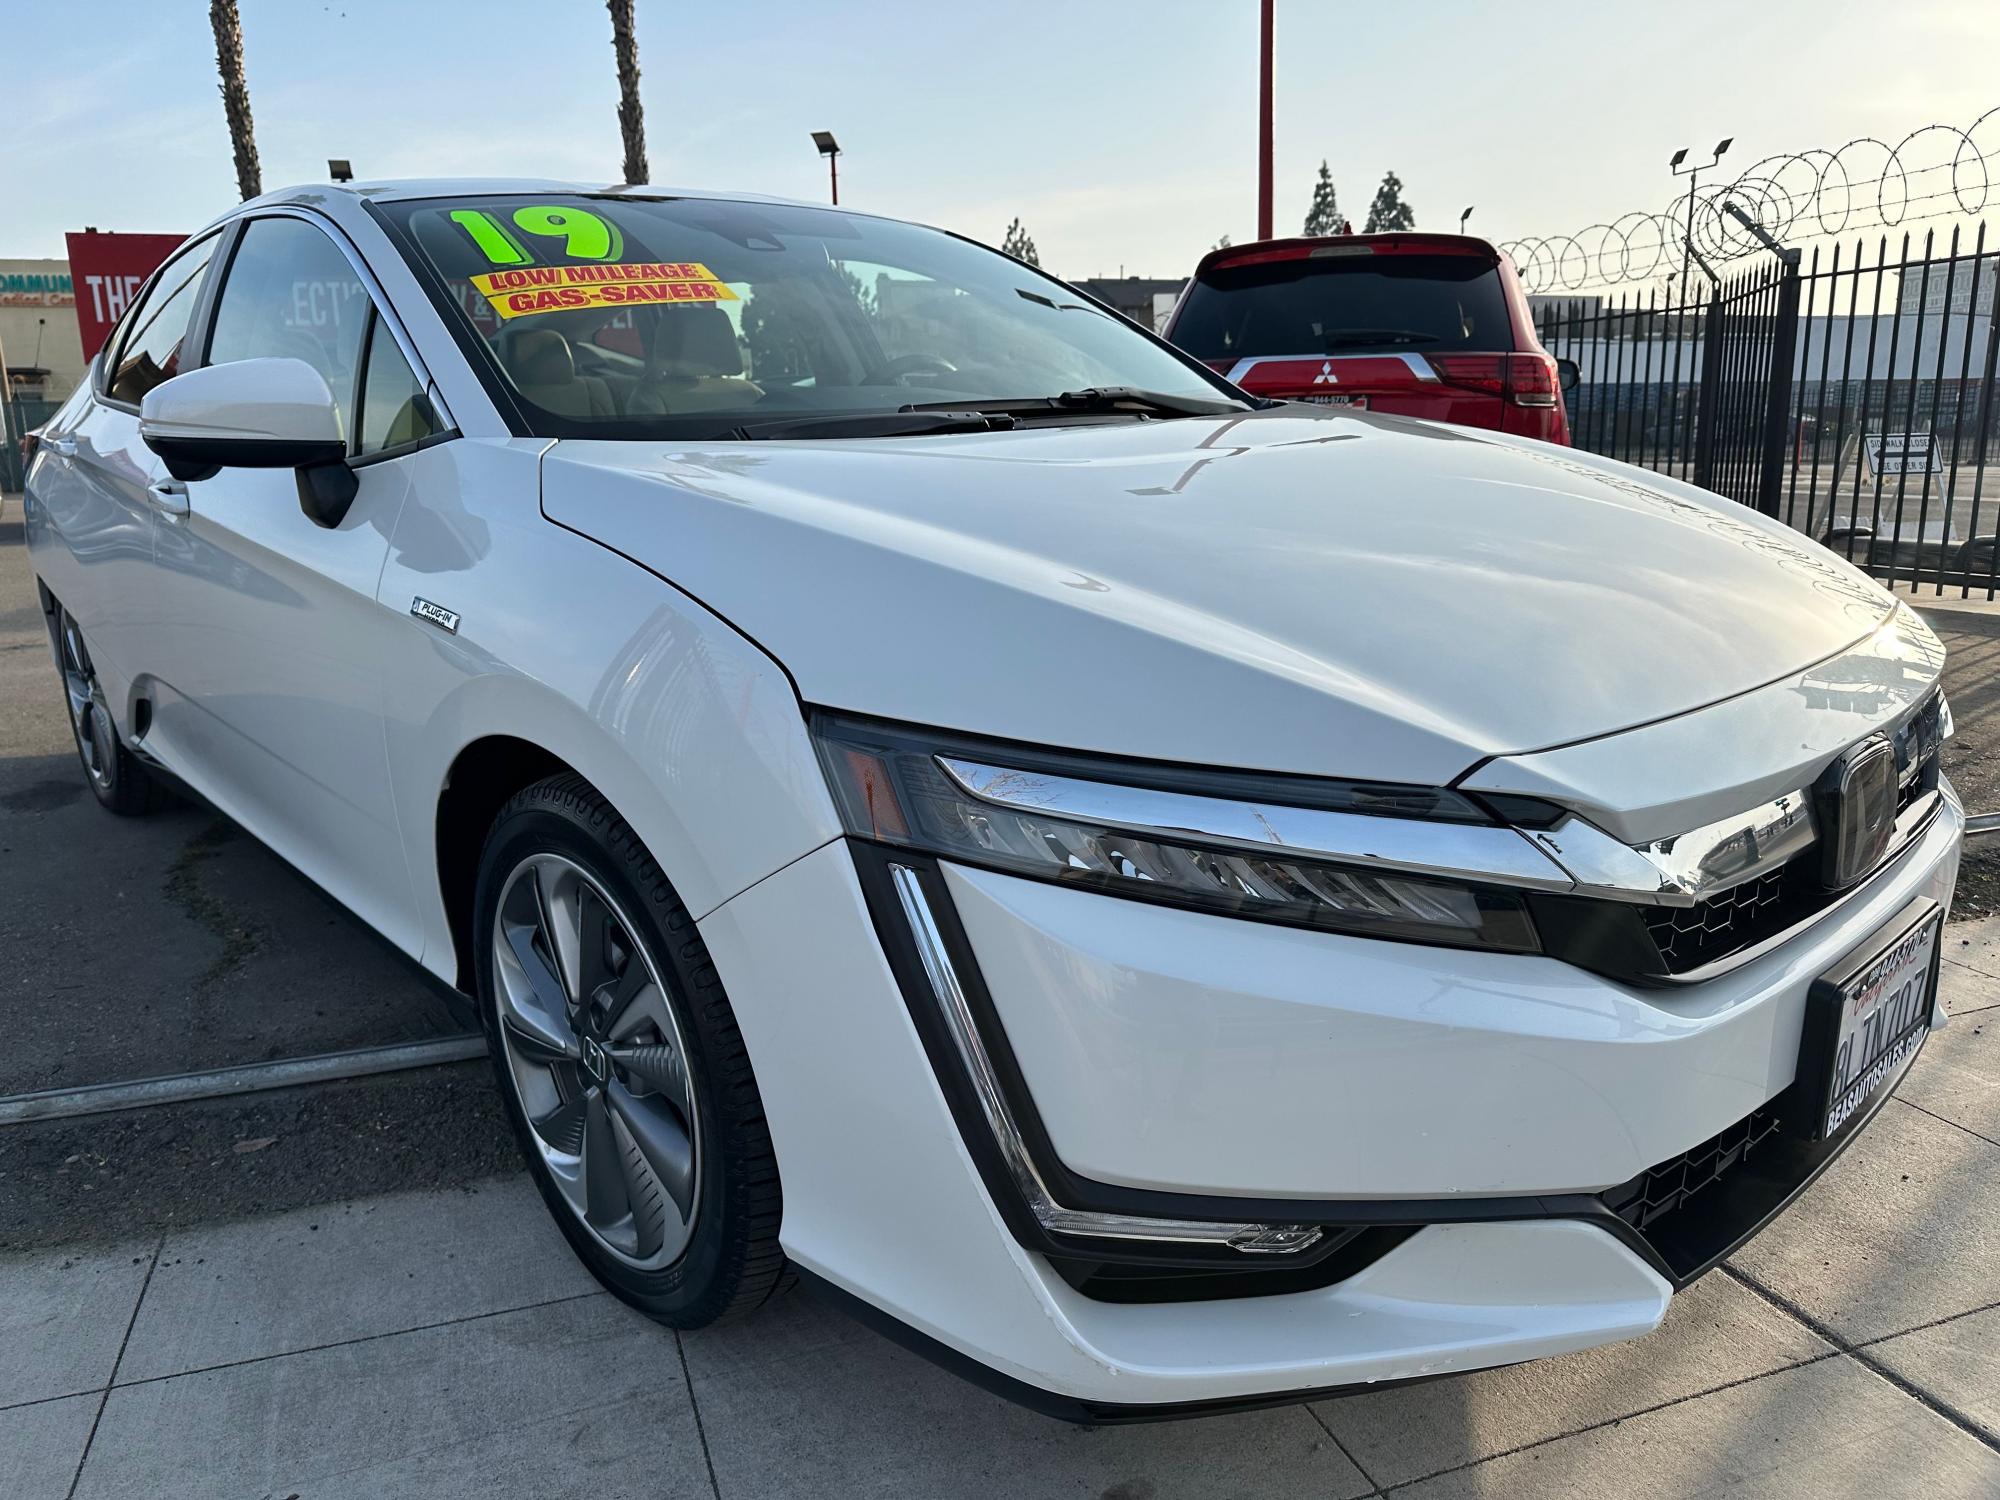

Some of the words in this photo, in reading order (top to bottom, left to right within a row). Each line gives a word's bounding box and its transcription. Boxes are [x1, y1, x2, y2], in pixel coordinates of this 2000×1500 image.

[450, 205, 623, 265] 19
[488, 267, 562, 291] LOW
[567, 264, 703, 283] MILEAGE
[507, 282, 720, 313] GAS-SAVER
[1870, 439, 1905, 448] SIDWALK
[1908, 438, 1930, 447] LOSE
[421, 603, 453, 623] PLUG-IN
